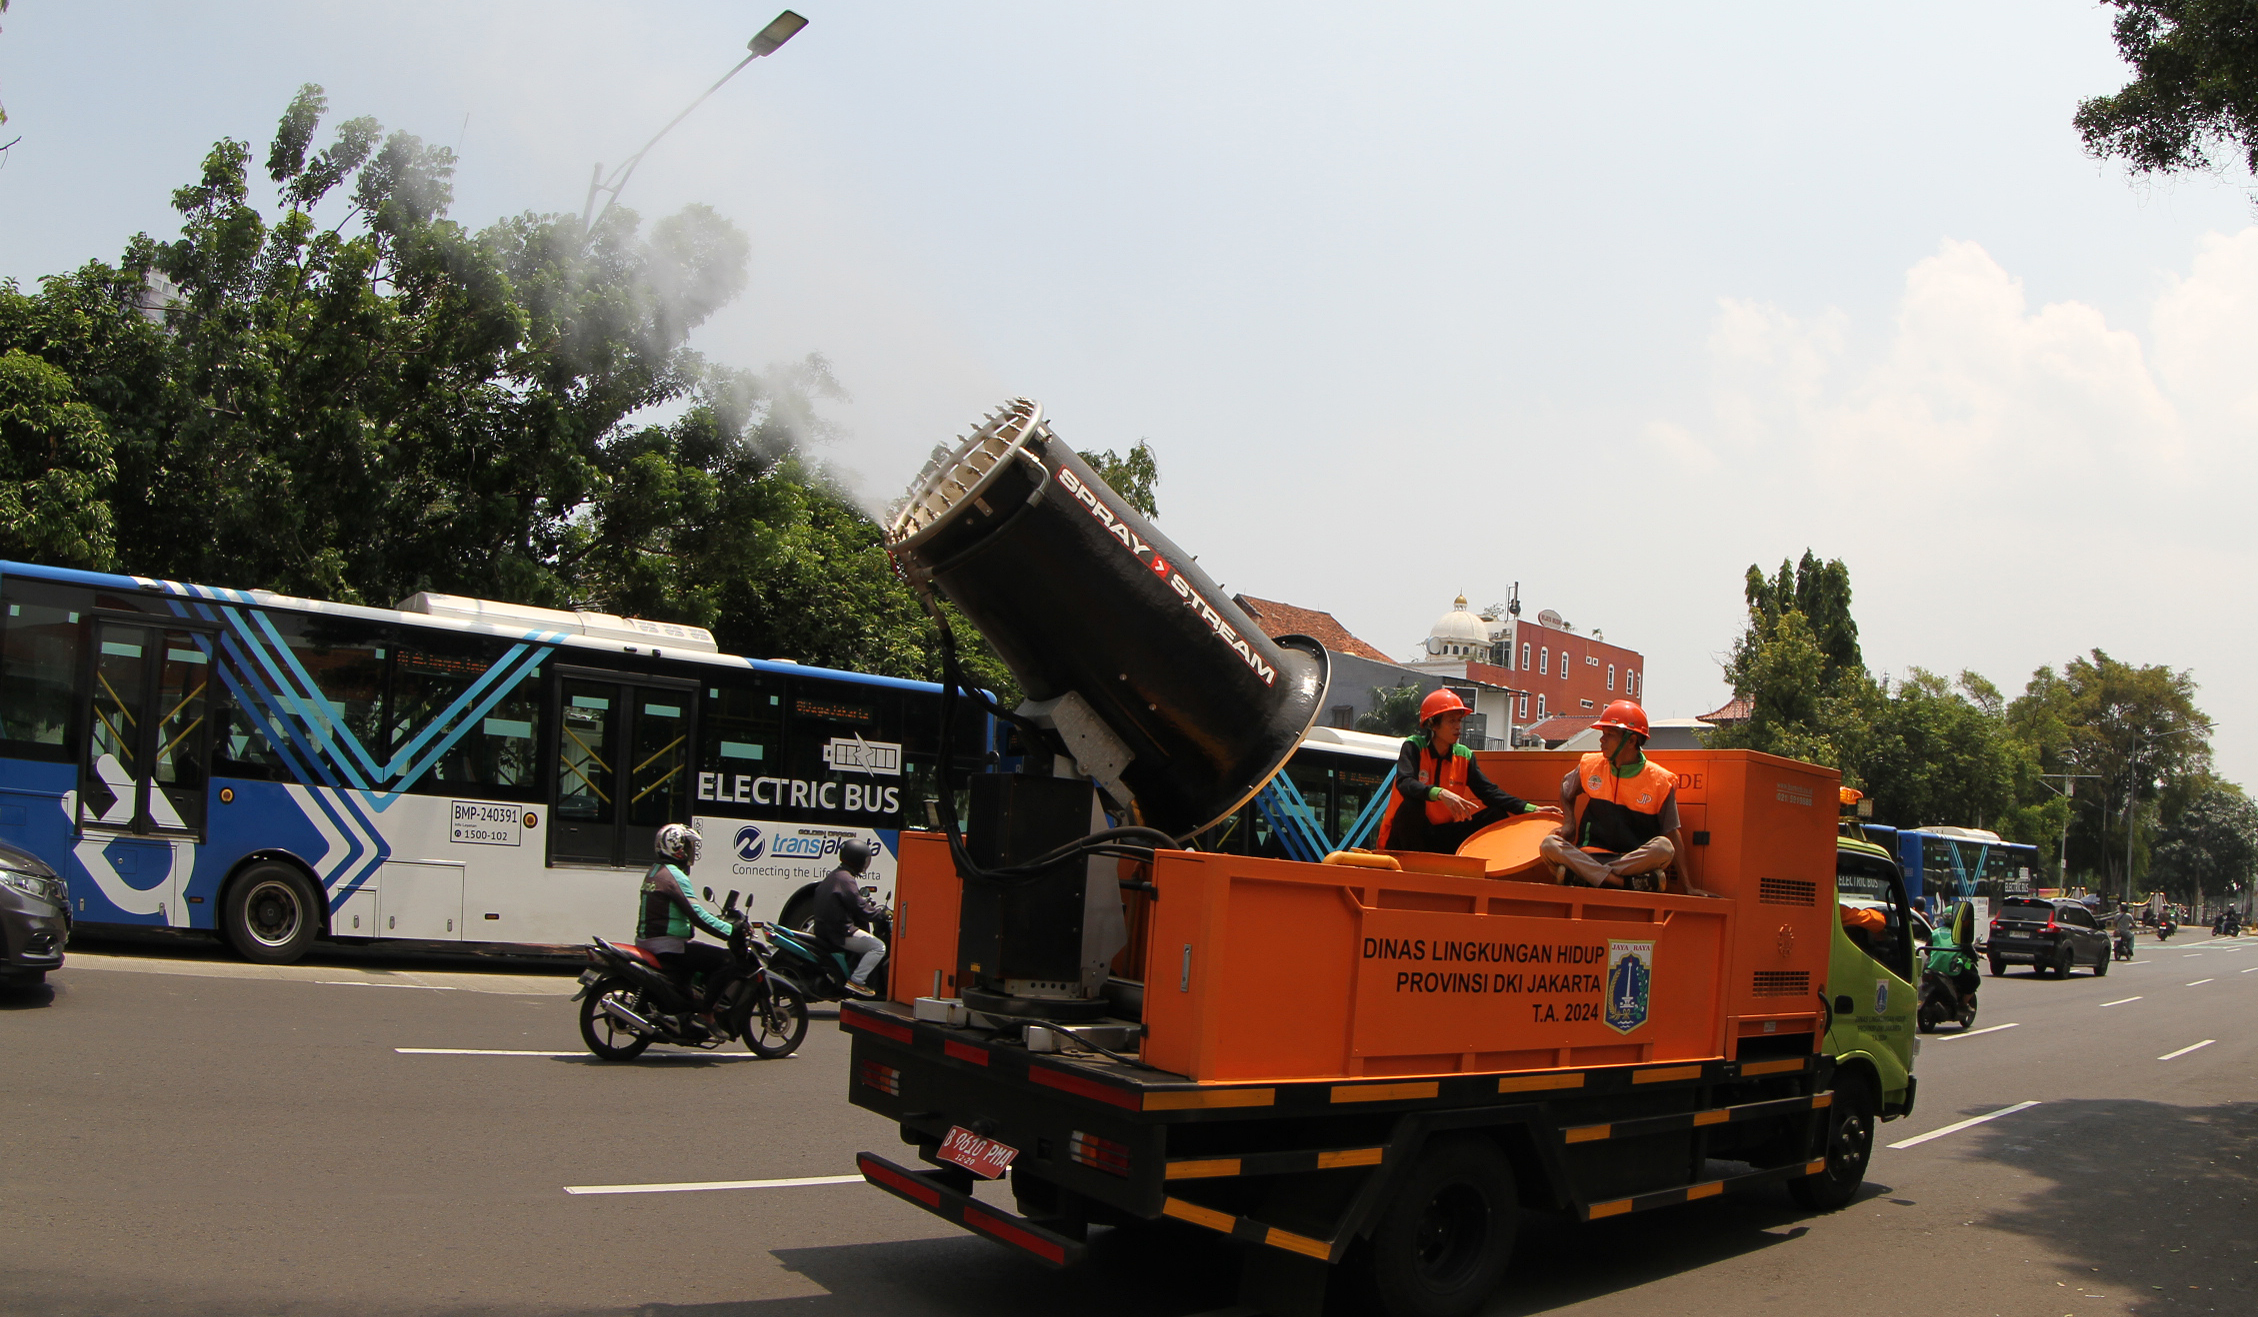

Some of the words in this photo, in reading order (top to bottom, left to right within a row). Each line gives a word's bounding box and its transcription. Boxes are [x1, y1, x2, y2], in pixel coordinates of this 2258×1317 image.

[1058, 468, 1151, 555] SPRAY
[1170, 573, 1276, 684] STREAM
[697, 771, 837, 809] ELECTRIC
[844, 783, 900, 814] BUS
[455, 805, 517, 823] BMP-240391
[464, 830, 508, 841] 1500-102
[798, 829, 827, 837] GOLDEN
[732, 863, 790, 879] Connecting
[793, 865, 810, 877] the
[1867, 878, 1878, 889] BUS
[1363, 938, 1426, 960] DINAS
[1432, 941, 1552, 963] LINGKUNGAN
[1557, 945, 1605, 964] HIDUP
[1396, 972, 1488, 993] PROVINSI
[1493, 974, 1523, 993] DKI
[1527, 974, 1601, 993] JAKARTA
[1532, 1004, 1559, 1023] T.A.
[1565, 1003, 1599, 1022] 2024
[944, 1129, 957, 1147] B
[953, 1133, 987, 1157] 9610
[983, 1144, 1014, 1168] PMA
